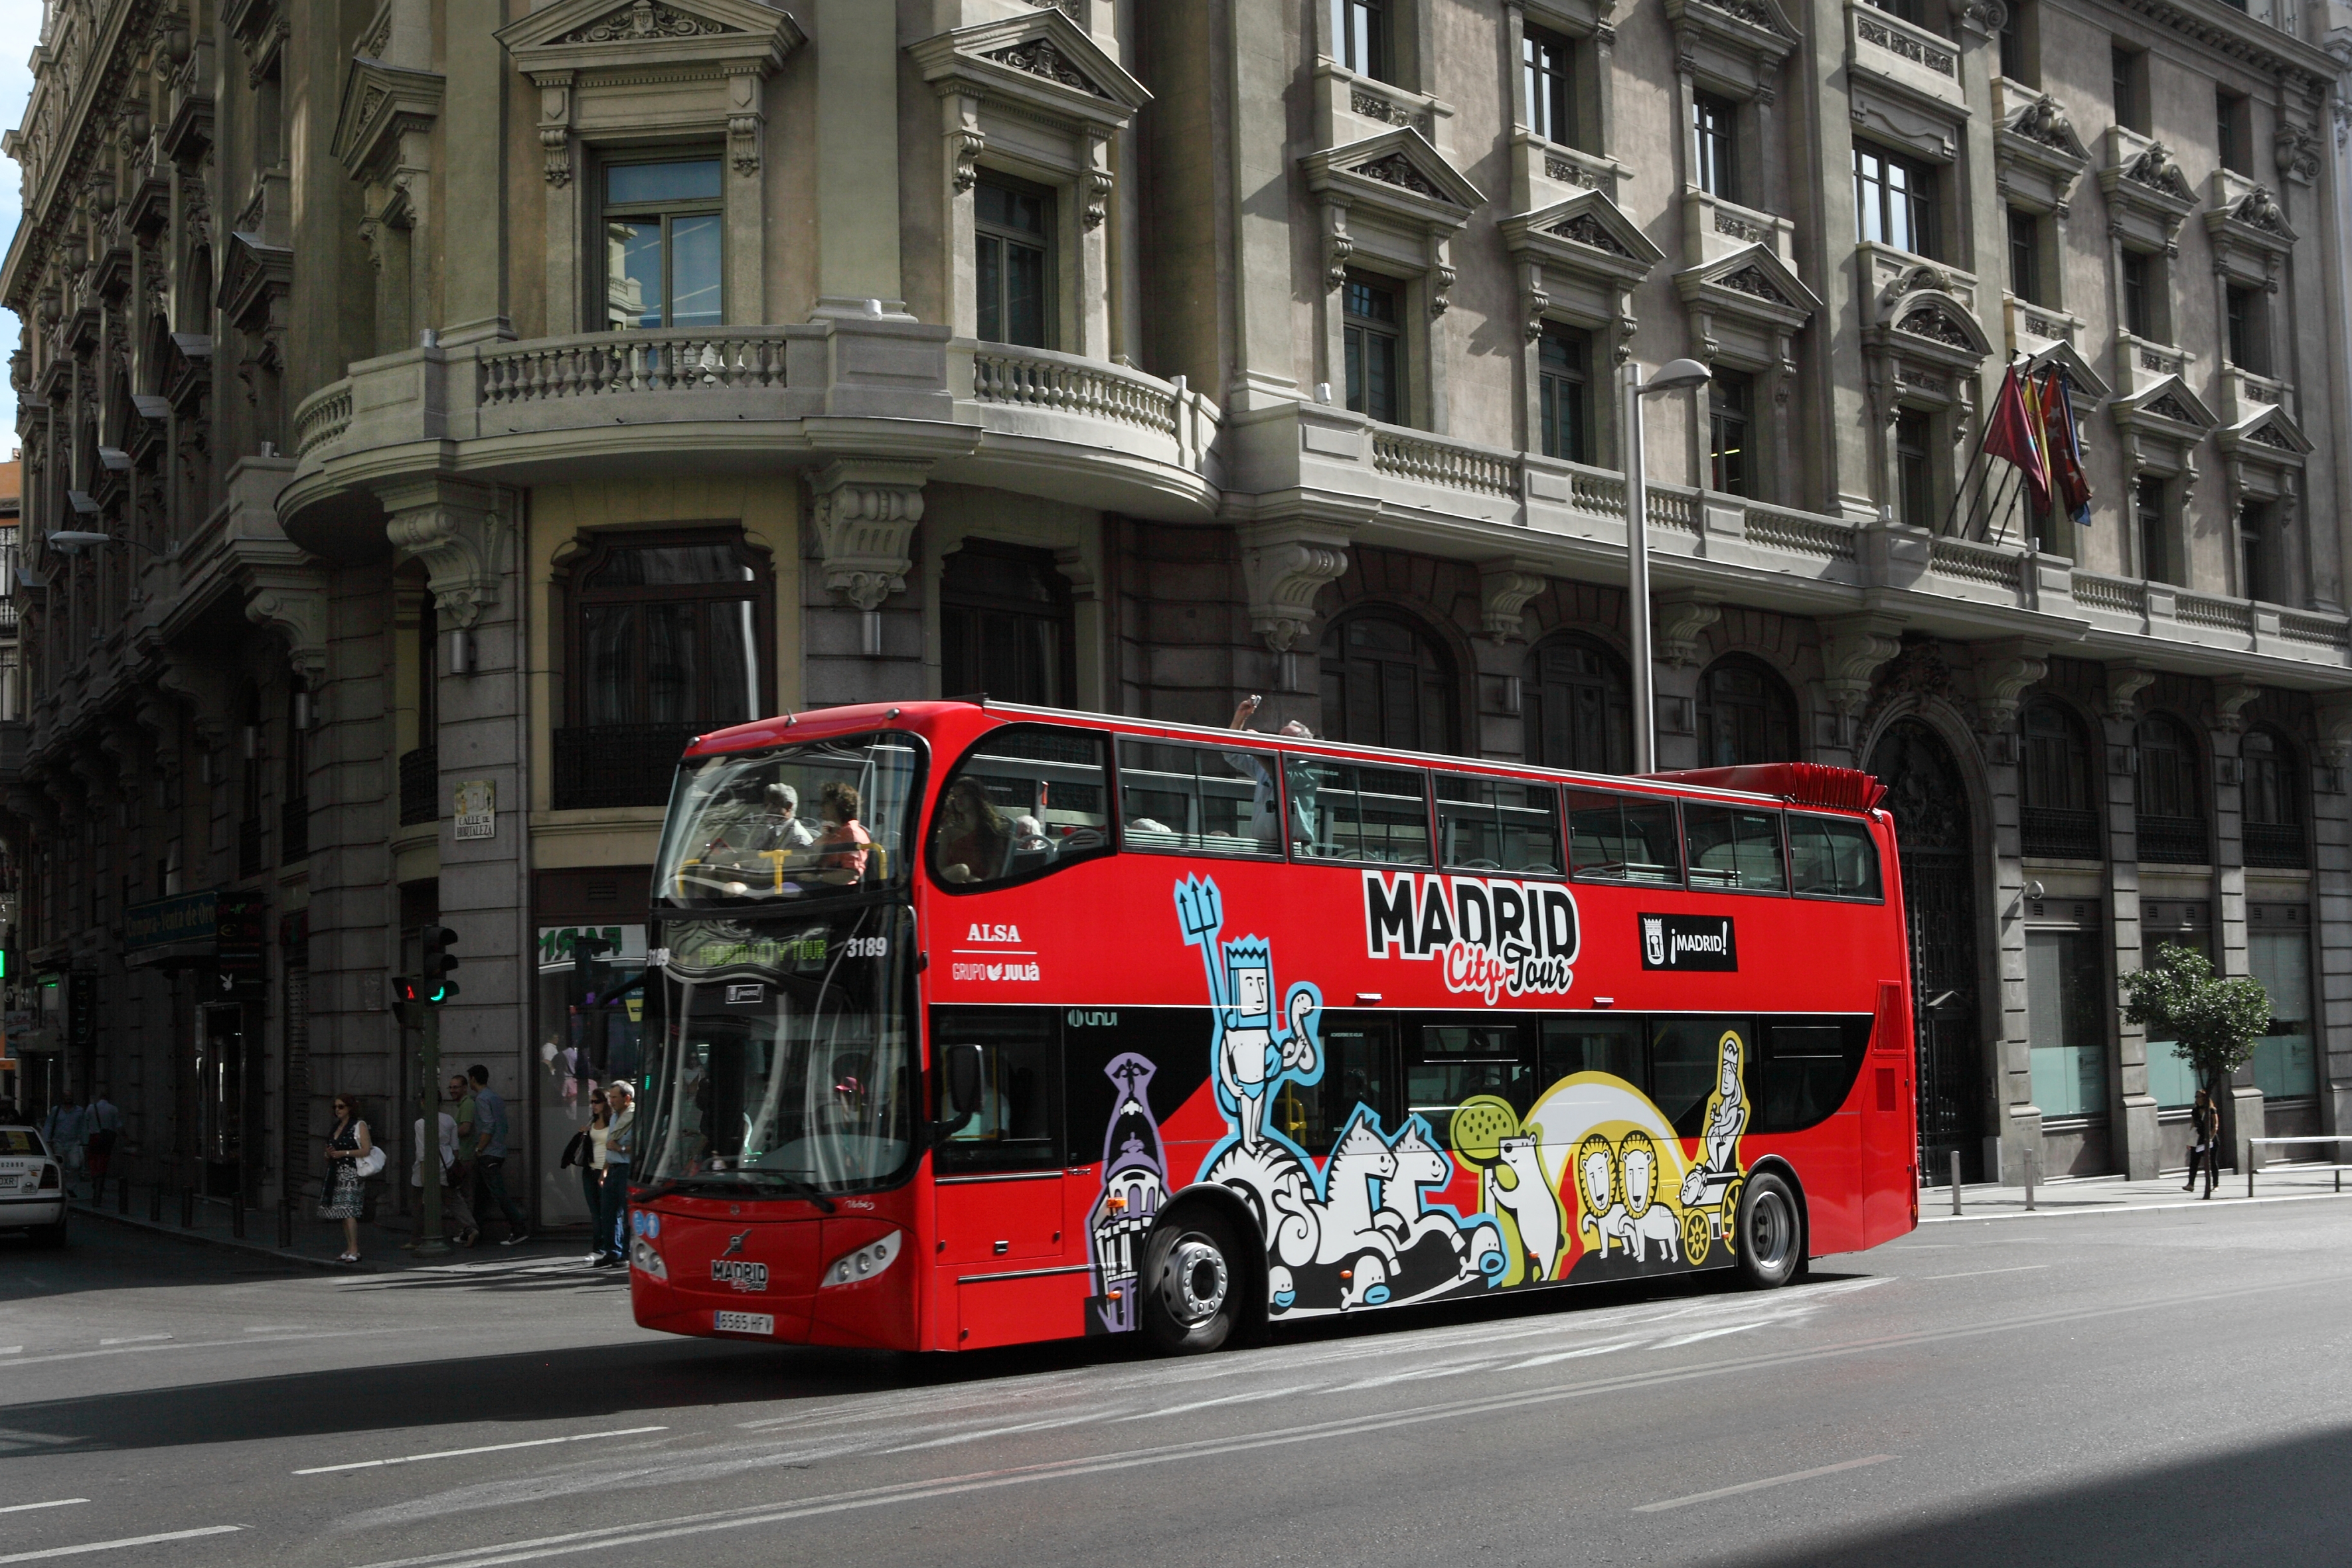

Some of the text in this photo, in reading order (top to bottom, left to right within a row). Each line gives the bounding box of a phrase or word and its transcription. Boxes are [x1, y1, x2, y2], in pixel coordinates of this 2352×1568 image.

[457, 824, 493, 838] HORTALEZA
[459, 816, 480, 826] CALLE
[187, 903, 197, 927] de
[199, 902, 215, 925] Oro
[1365, 874, 1579, 963] MADRID
[967, 923, 1022, 942] ALSA
[1670, 921, 1727, 964] ¡MADRID!
[751, 941, 788, 963] CITY
[793, 939, 827, 960] TOUR
[846, 937, 887, 957] 3189
[952, 963, 986, 980] GRUPO
[1447, 941, 1571, 1001] City Tour
[712, 1260, 767, 1283] MADRID
